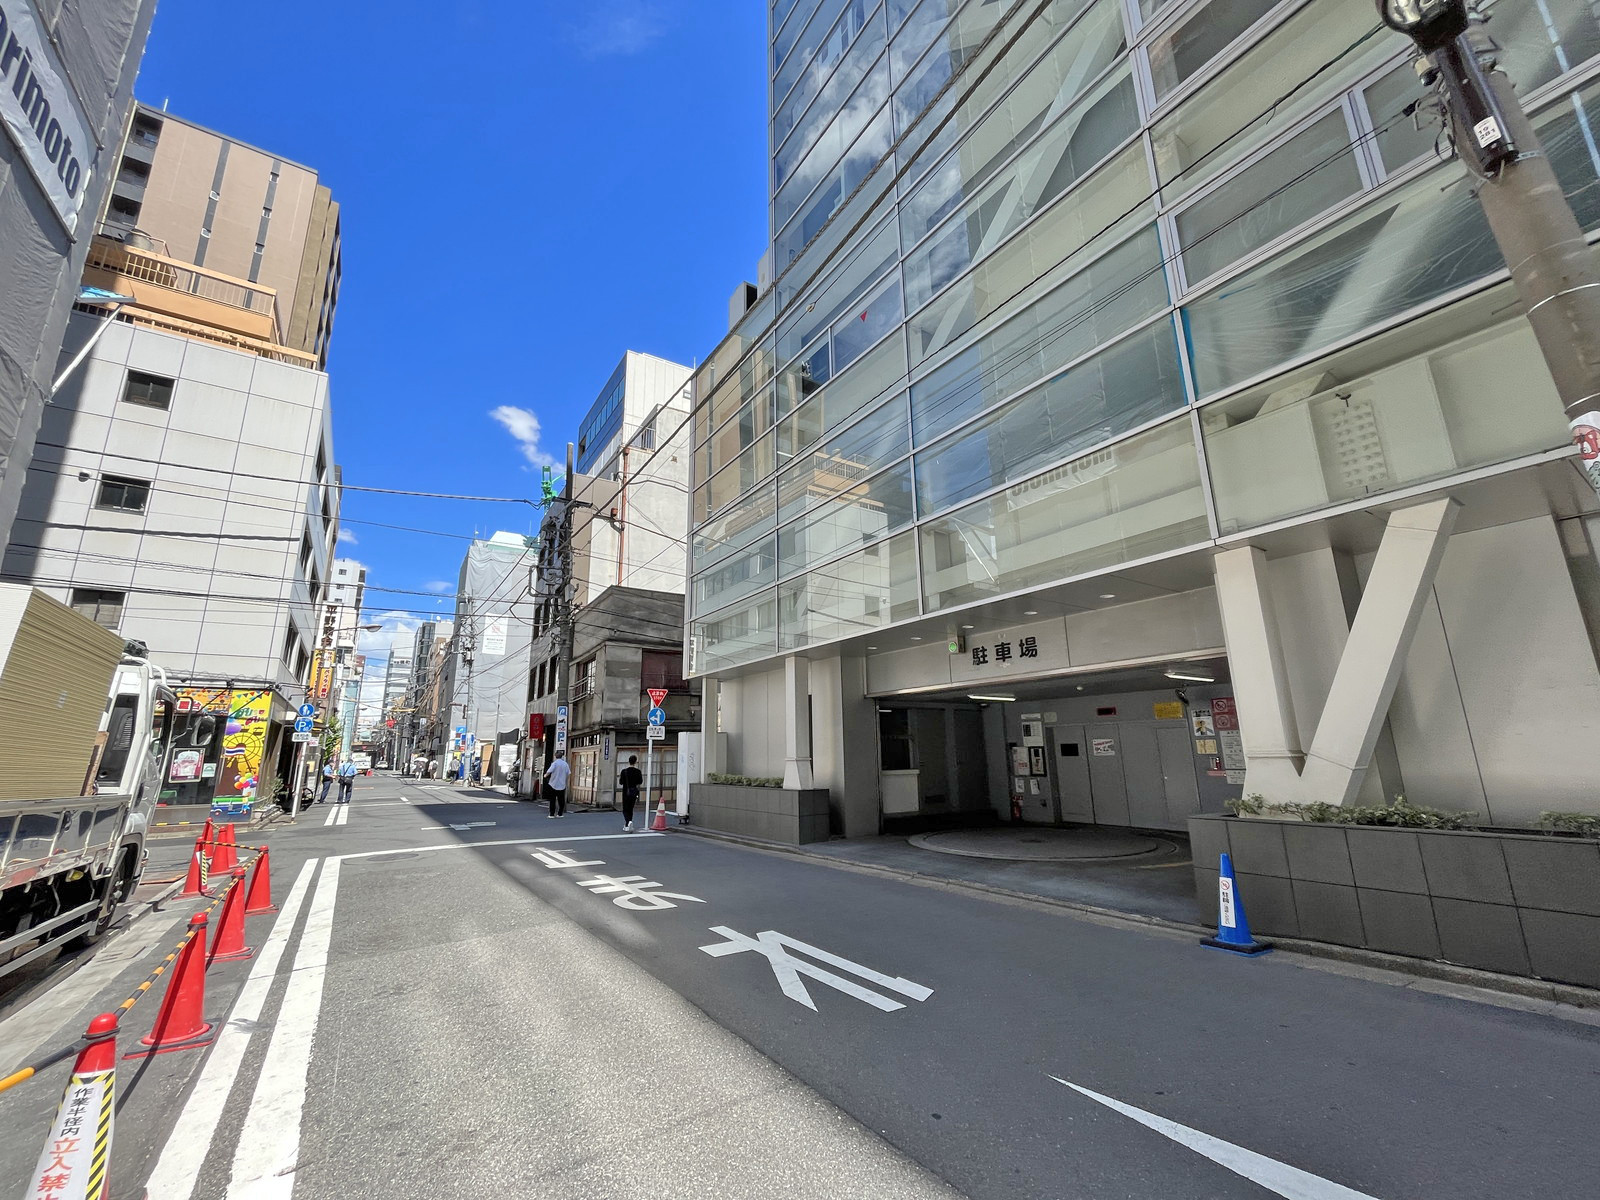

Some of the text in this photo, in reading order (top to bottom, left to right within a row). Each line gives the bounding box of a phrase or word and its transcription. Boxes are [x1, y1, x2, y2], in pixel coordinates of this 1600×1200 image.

[972, 636, 1038, 666] 駐車場
[299, 721, 306, 731] P
[531, 847, 934, 1012] 止まれ
[60, 1087, 94, 1138] 作業半径内
